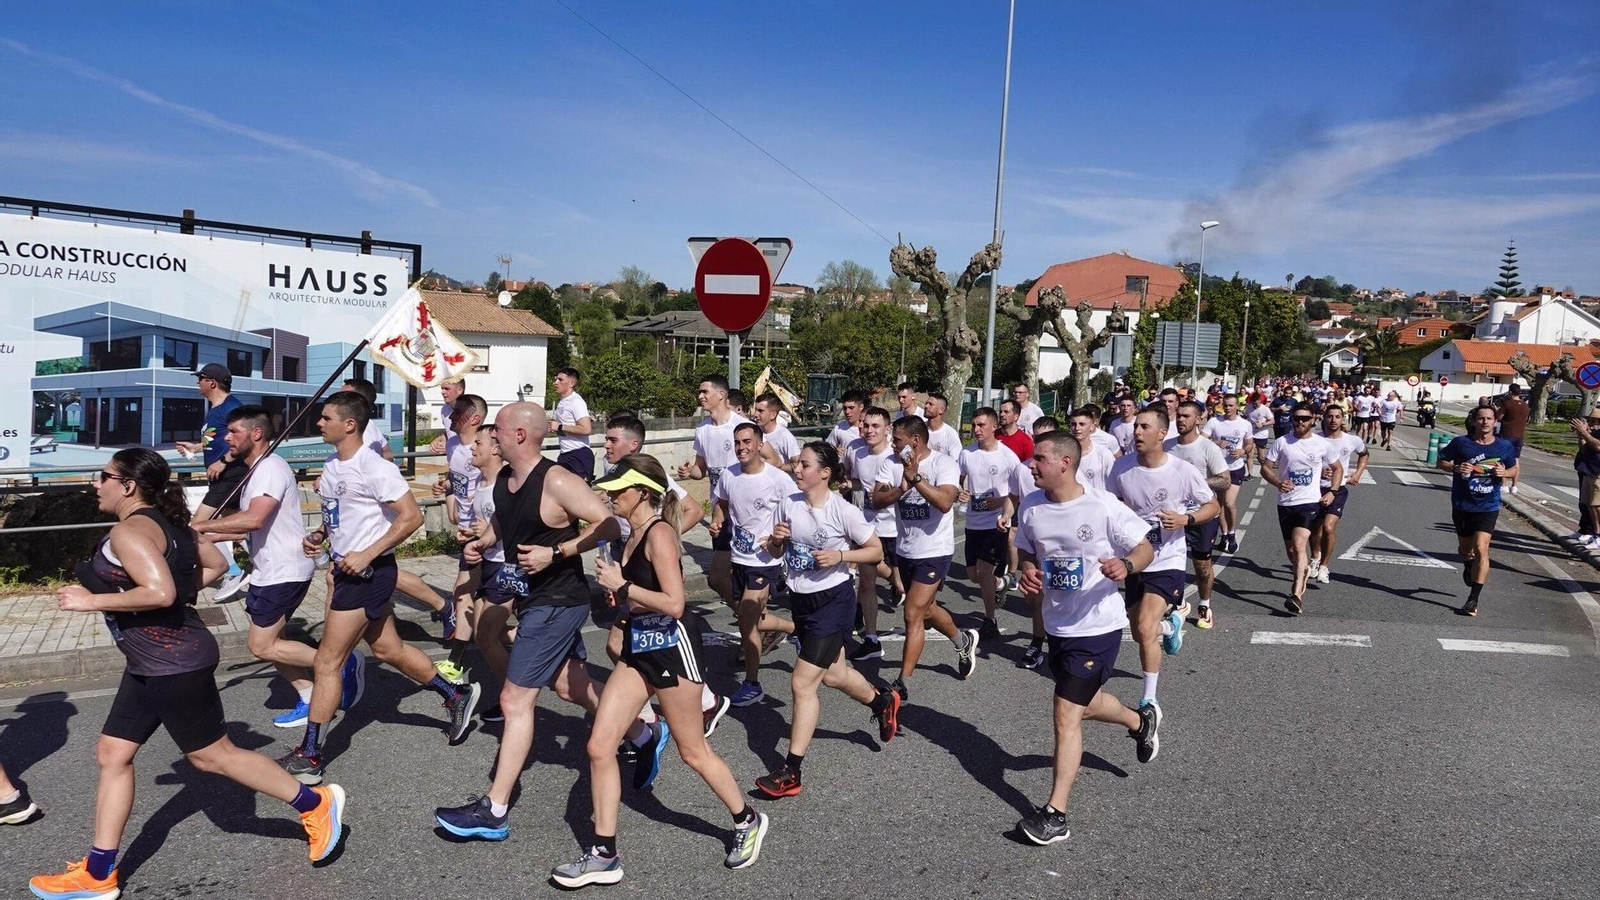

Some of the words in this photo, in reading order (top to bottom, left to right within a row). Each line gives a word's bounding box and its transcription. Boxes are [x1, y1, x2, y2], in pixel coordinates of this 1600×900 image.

[16, 242, 186, 272] CONSTRUCCIÓN
[0, 262, 63, 280] ODULAR
[67, 268, 116, 284] HAUSS
[268, 263, 388, 297] HAUSS
[268, 291, 341, 305] ARQUITECTURA
[343, 297, 387, 308] MODULAR
[904, 508, 925, 518] 3318
[789, 555, 815, 570] 3384
[1052, 574, 1079, 587] 3348
[639, 631, 672, 648] 3781
